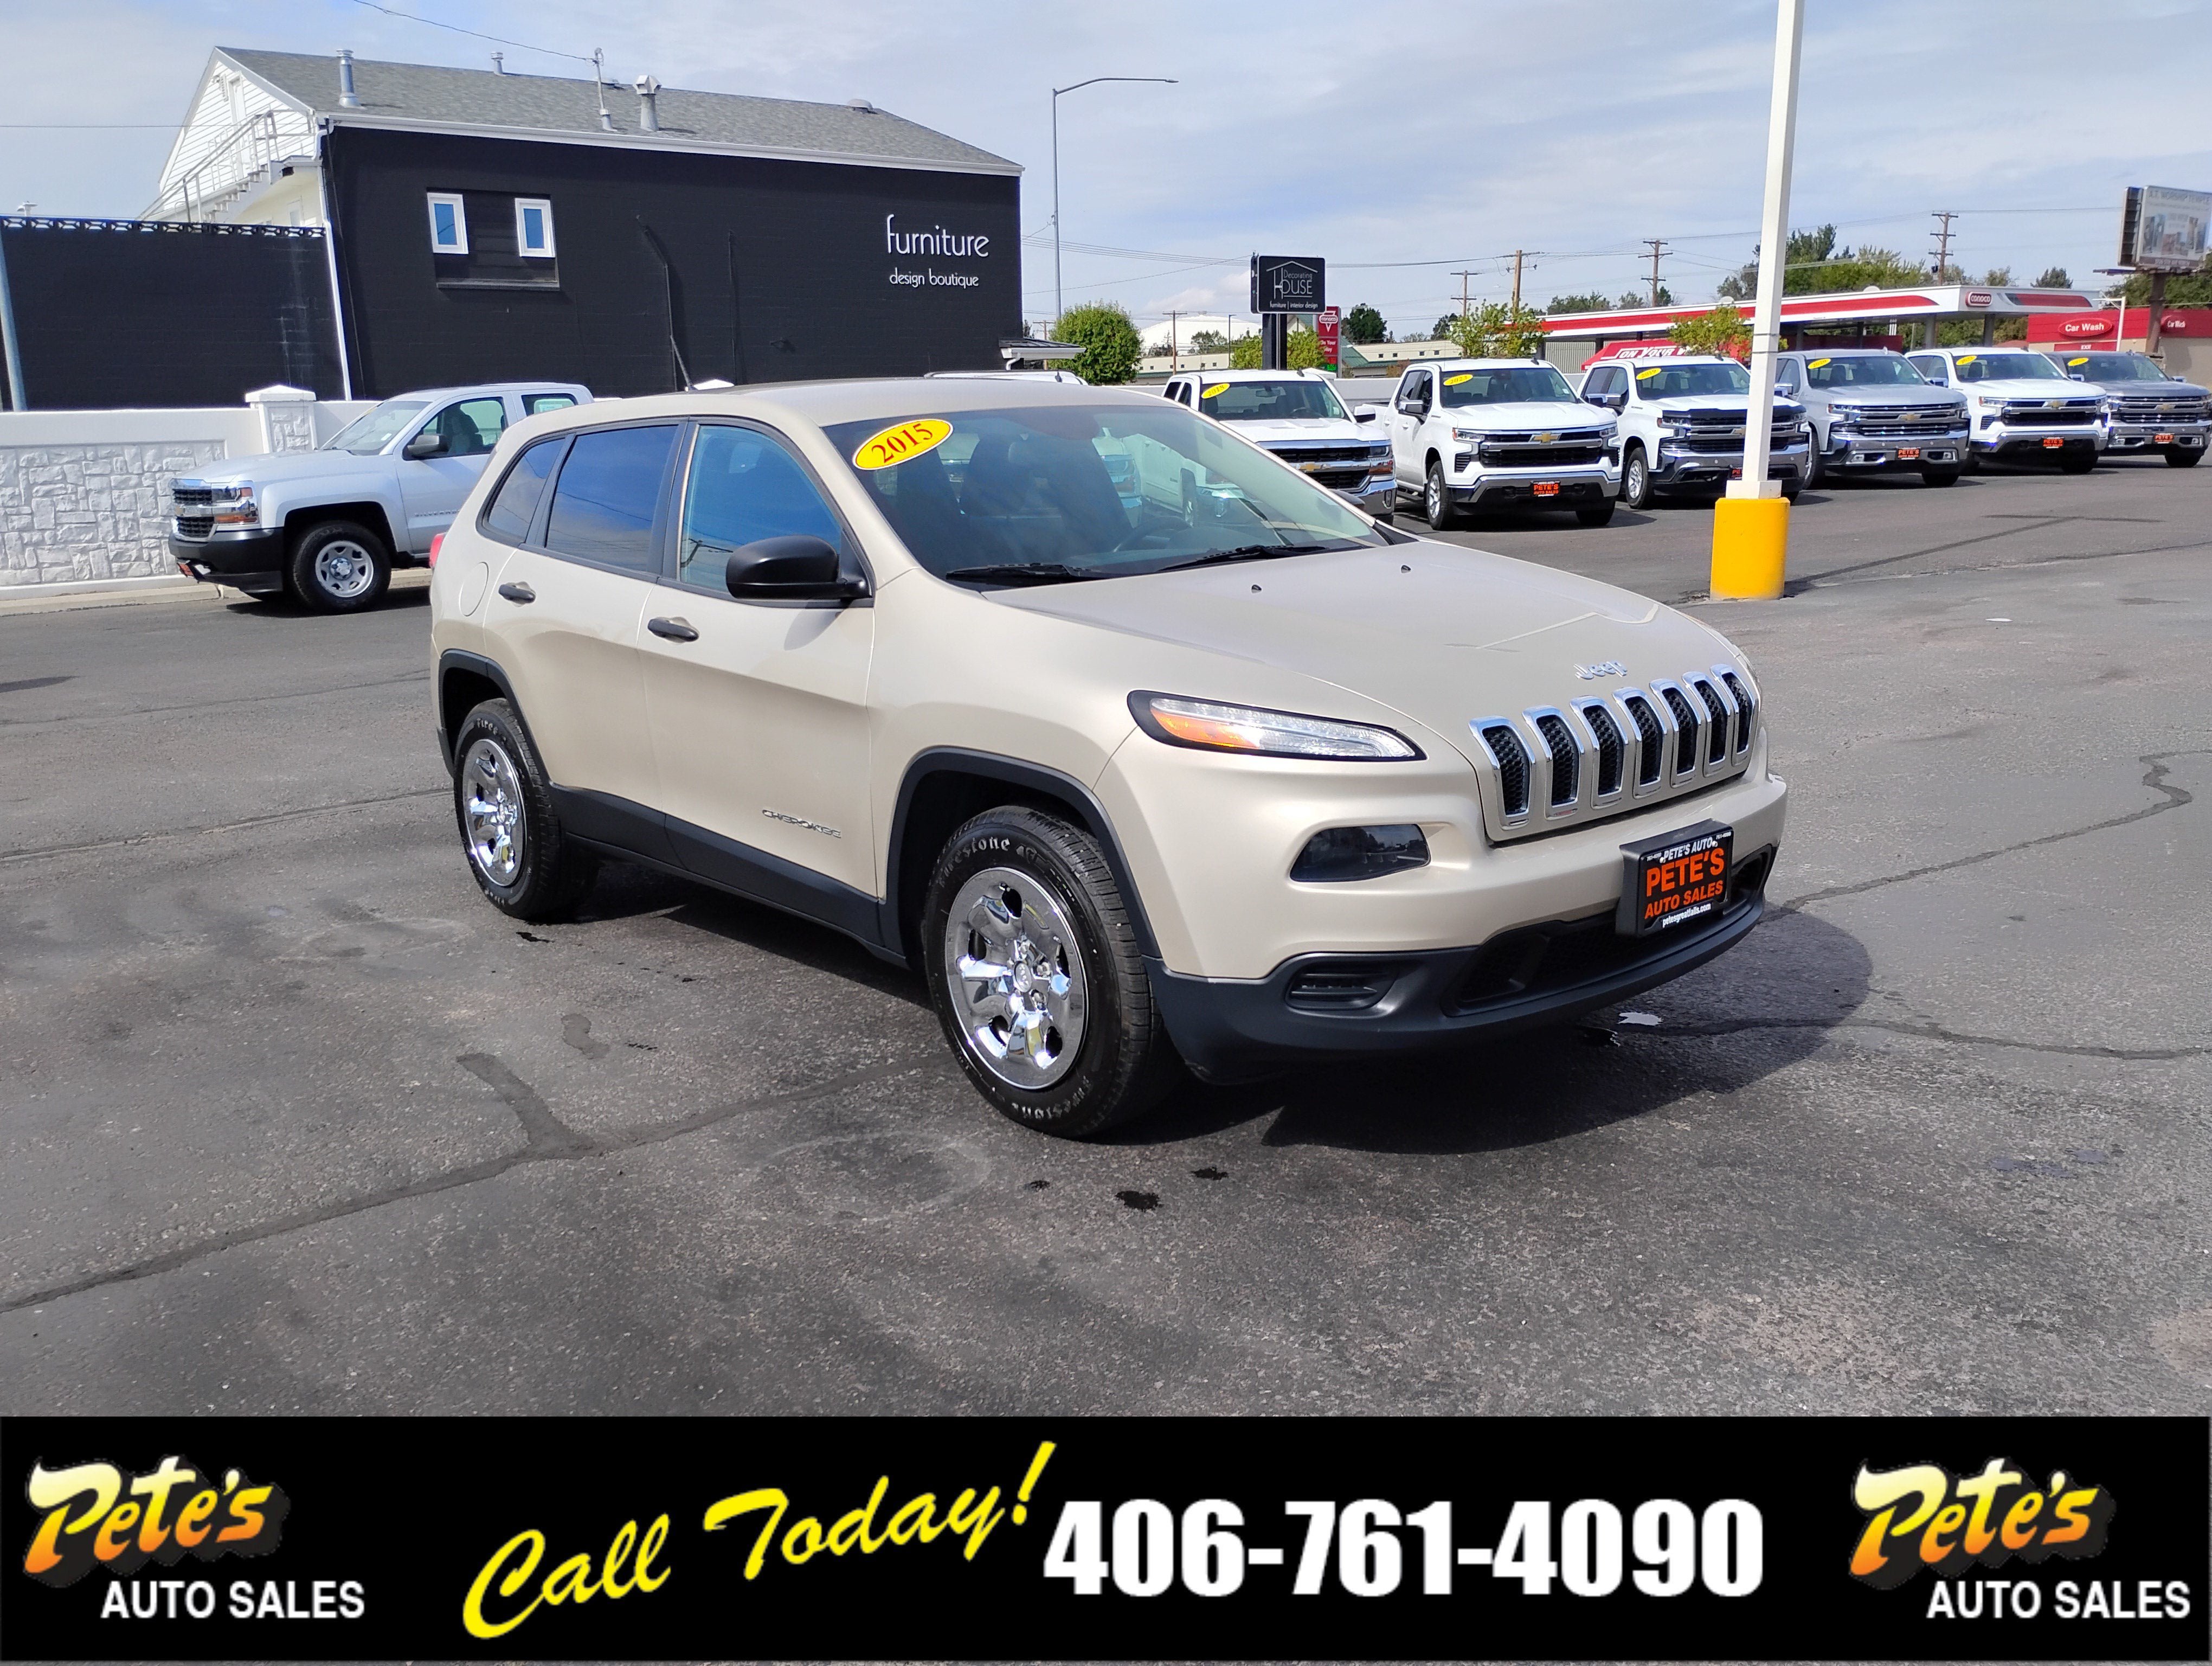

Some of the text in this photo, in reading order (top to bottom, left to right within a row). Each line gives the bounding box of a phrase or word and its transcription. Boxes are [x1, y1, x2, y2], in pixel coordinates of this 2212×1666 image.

[887, 214, 989, 257] furniture
[889, 267, 979, 289] design boutique
[1283, 270, 1313, 280] Decorating
[1270, 300, 1287, 309] furniture
[1304, 302, 1319, 310] design
[2082, 323, 2104, 331] Wash
[871, 423, 933, 464] 2015
[1573, 659, 1628, 680] Jeep
[762, 809, 841, 838] CHEROKEE
[1663, 836, 1713, 861] PETE'S AUTO
[1646, 847, 1725, 897] PETE'S
[1644, 880, 1724, 920] AUTO SALES
[1662, 902, 1712, 928] petesgreatfalls.com
